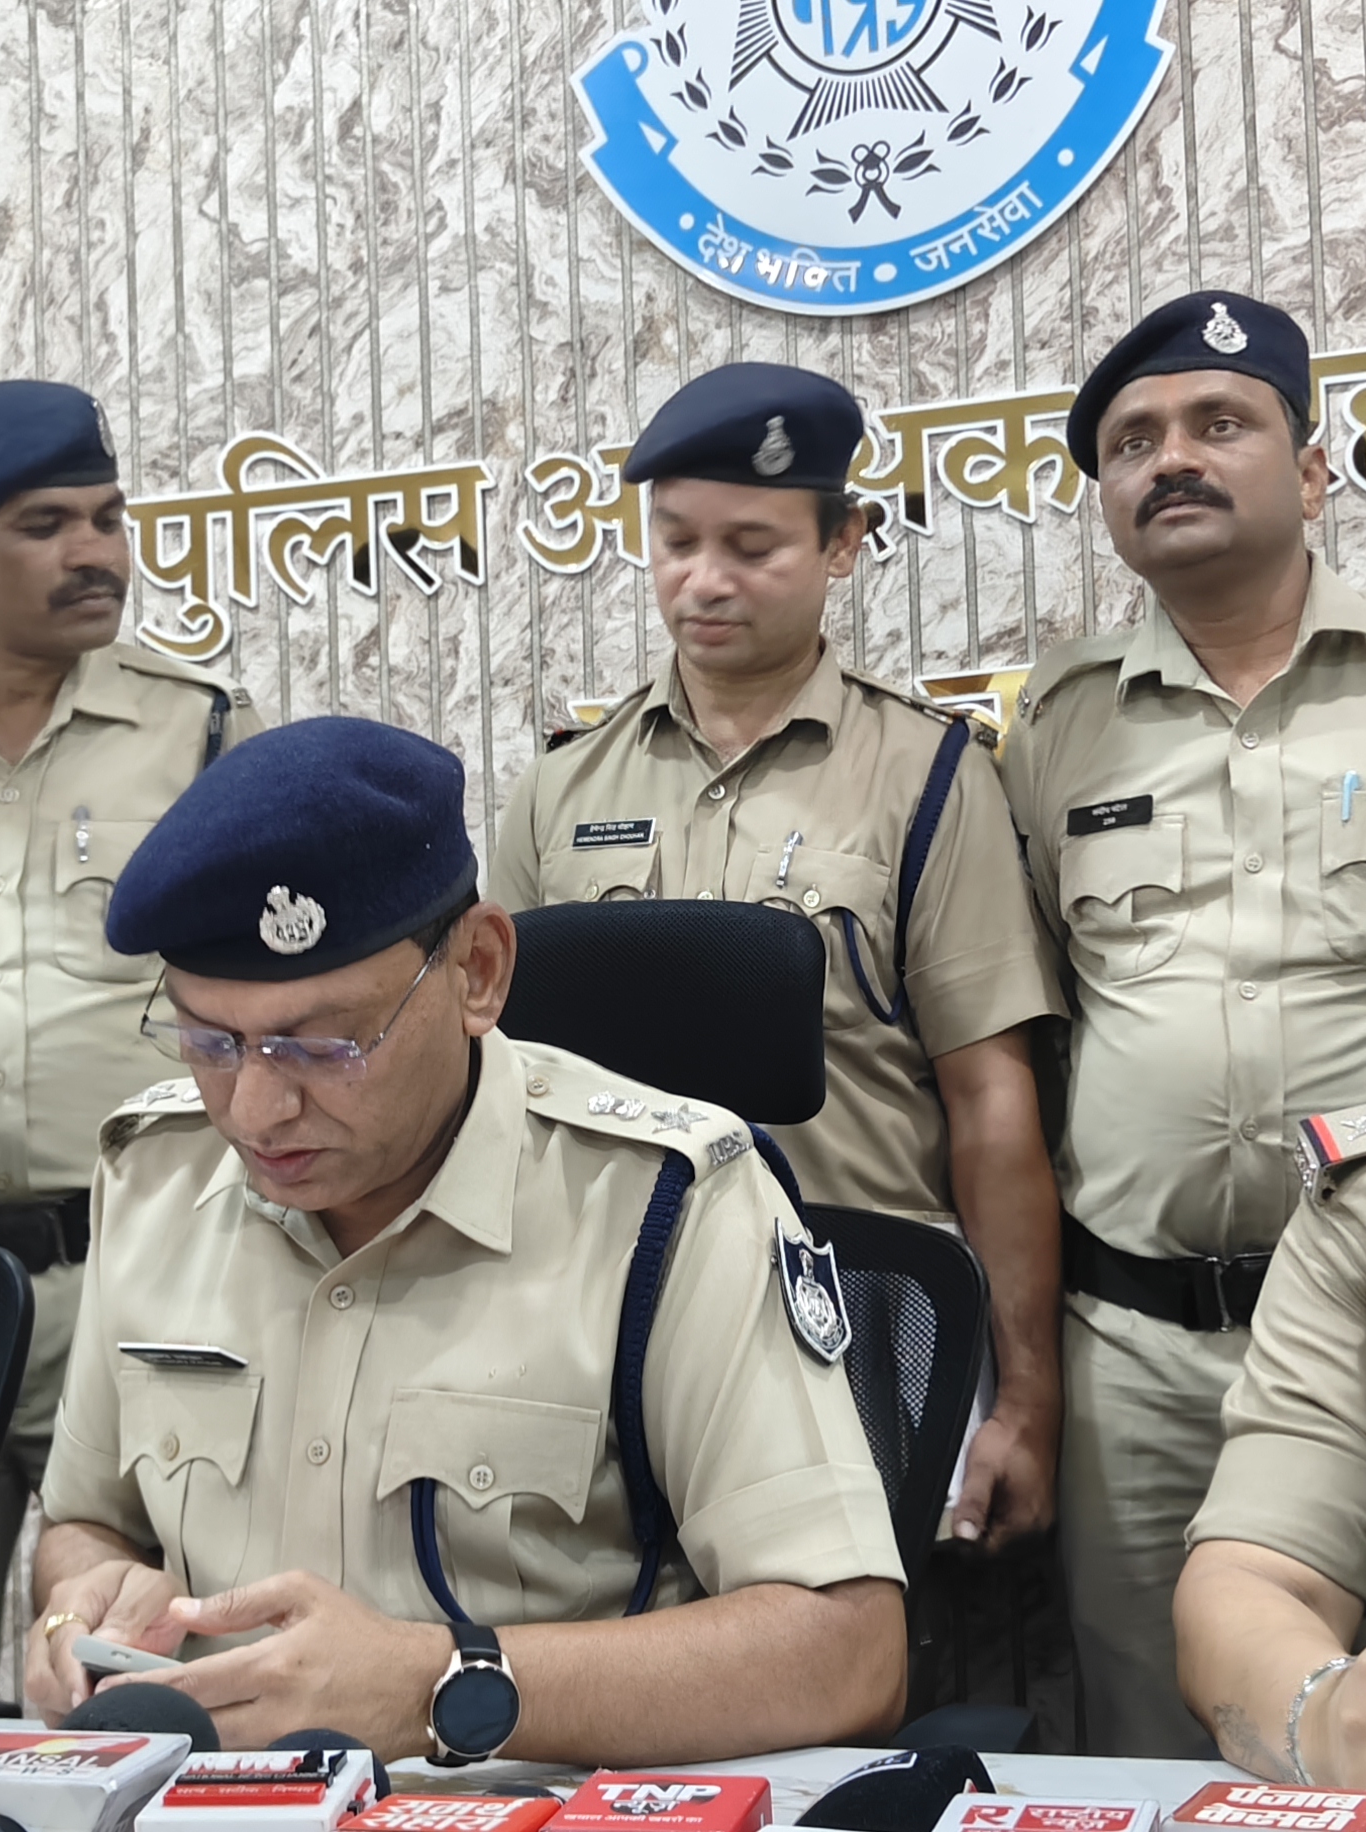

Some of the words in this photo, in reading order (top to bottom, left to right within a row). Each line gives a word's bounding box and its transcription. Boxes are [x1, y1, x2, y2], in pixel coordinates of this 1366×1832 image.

[126, 430, 495, 662] पुलिस
[597, 1783, 722, 1801] TNP
[1226, 1785, 1366, 1810] पंजाब
[387, 1797, 535, 1816] समर्थ
[1194, 1802, 1357, 1831] केसरी
[362, 1811, 510, 1832] सहारा
